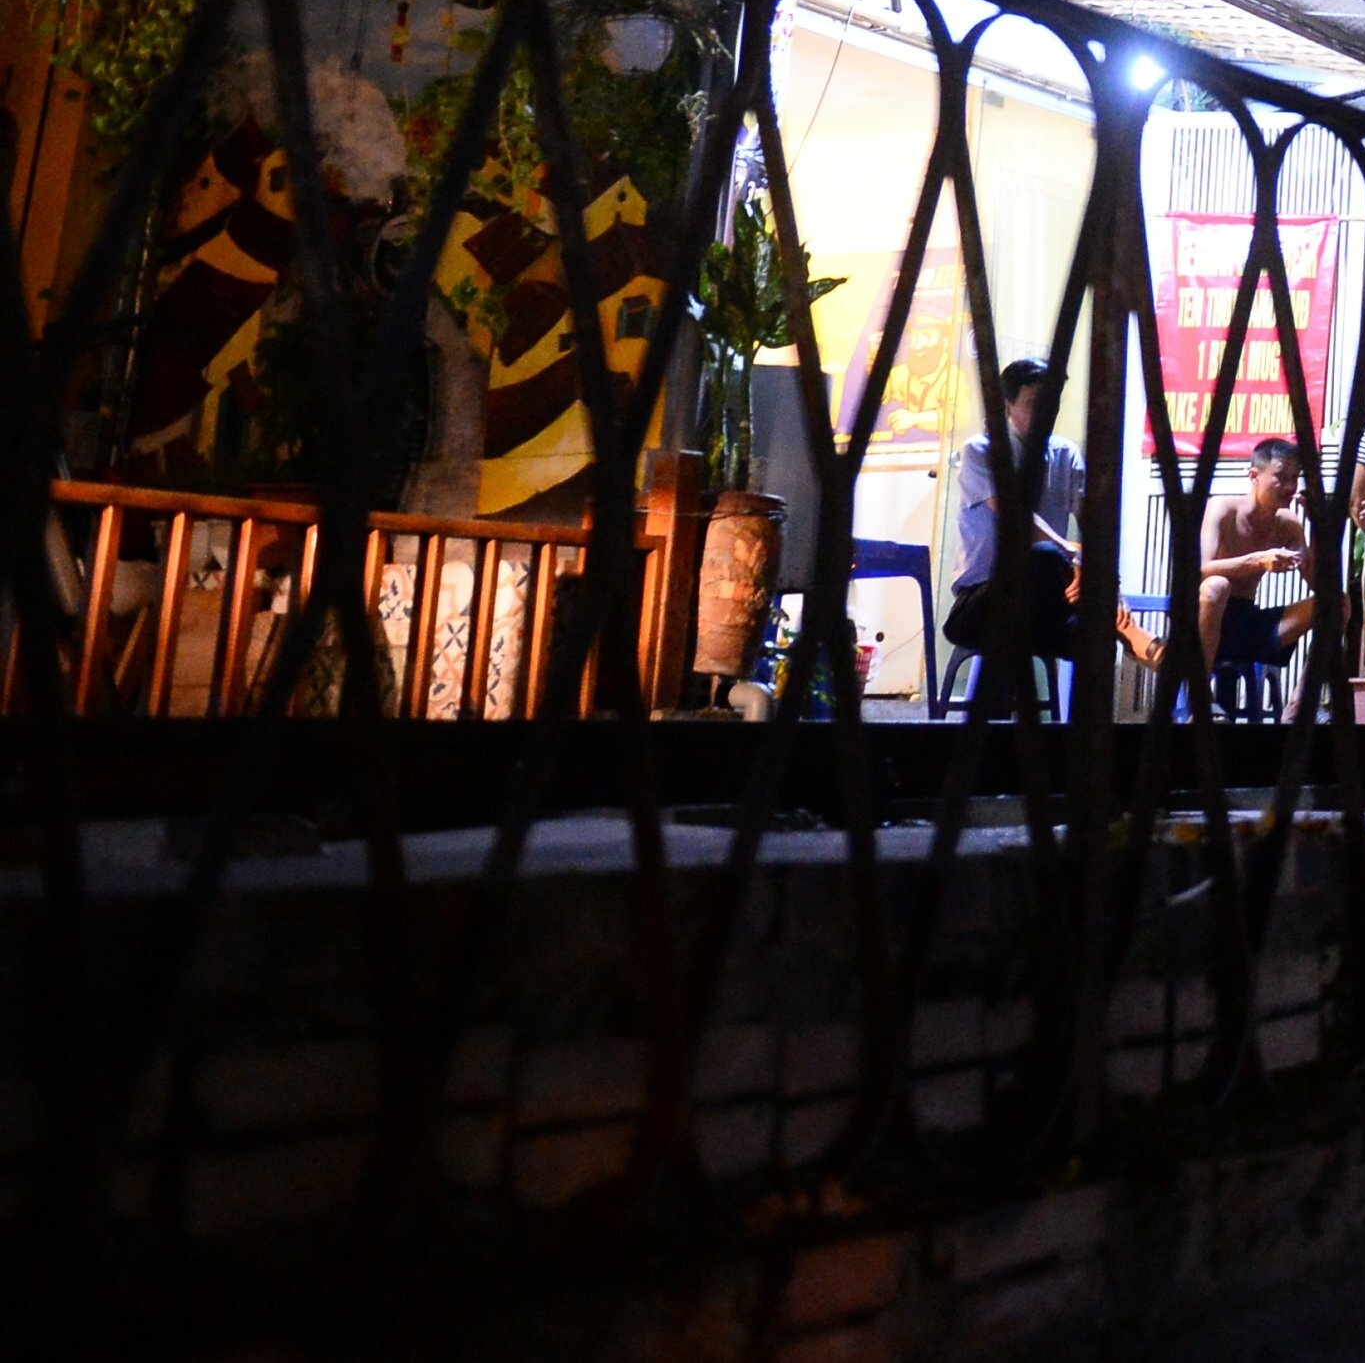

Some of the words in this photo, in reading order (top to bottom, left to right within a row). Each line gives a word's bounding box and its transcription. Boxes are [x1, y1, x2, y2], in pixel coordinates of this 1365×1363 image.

[1178, 287, 1205, 327] TEN
[1198, 341, 1206, 380] 1
[1247, 341, 1281, 382] MUG
[1199, 392, 1247, 434] AAY
